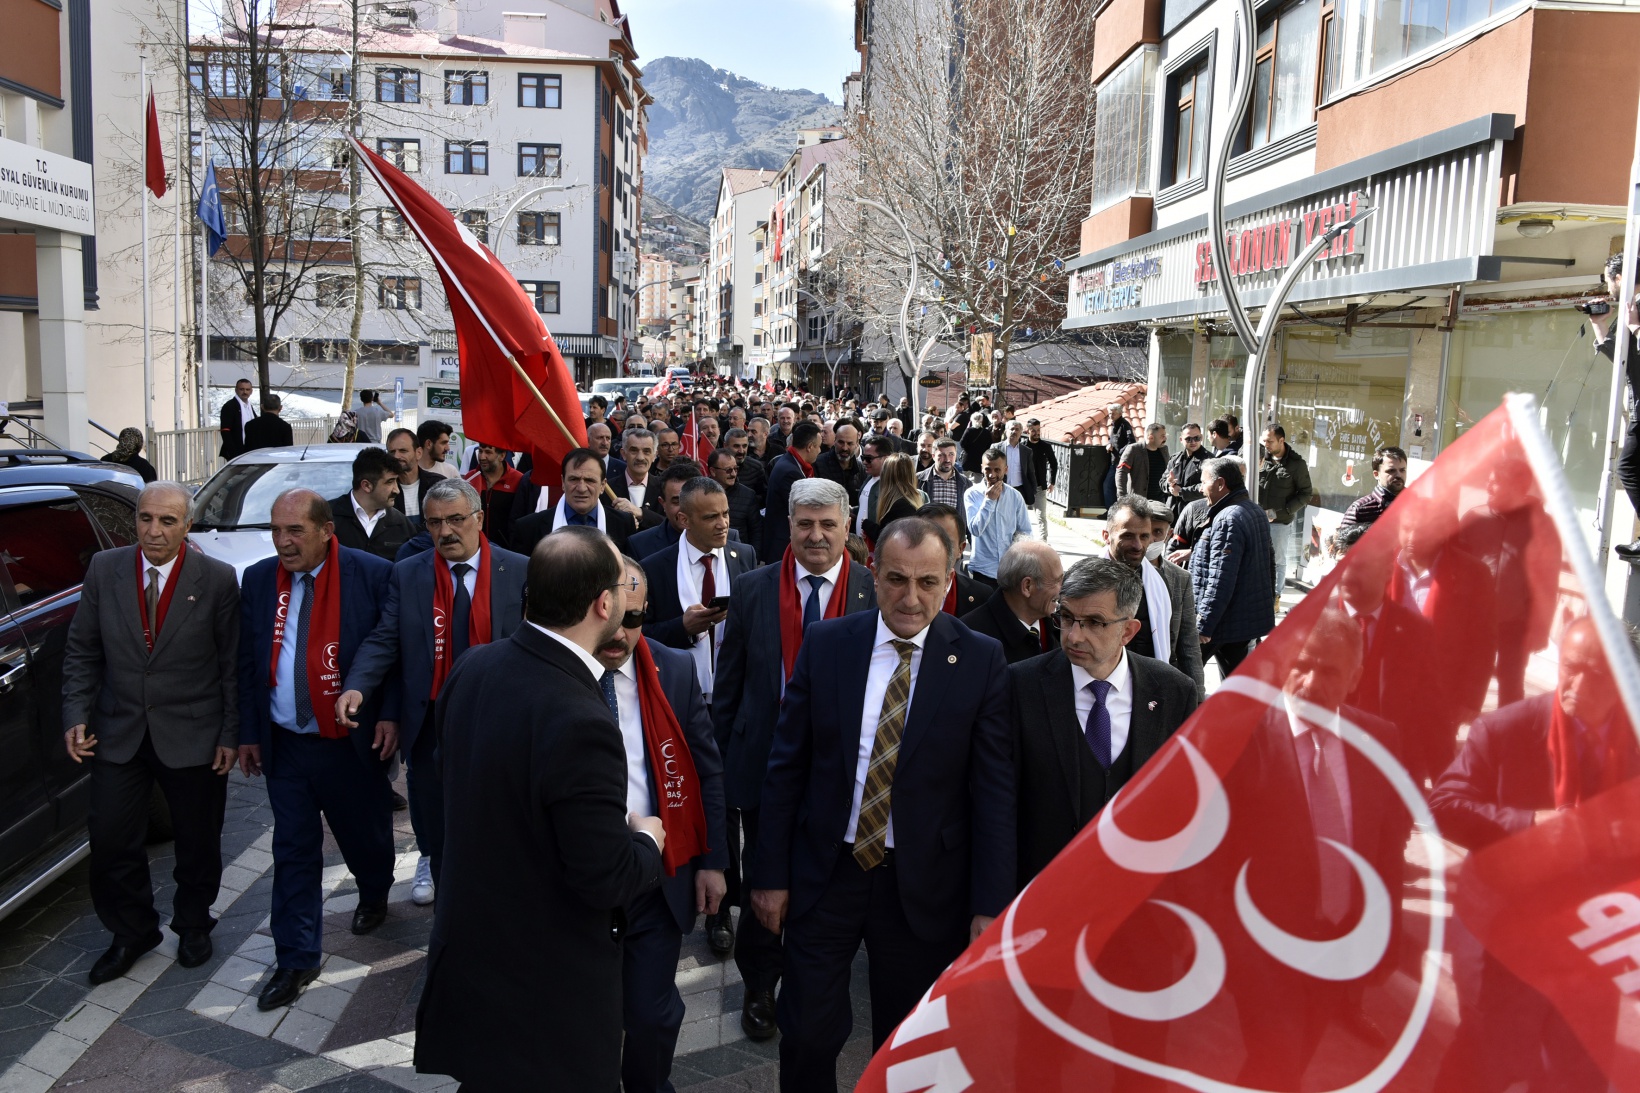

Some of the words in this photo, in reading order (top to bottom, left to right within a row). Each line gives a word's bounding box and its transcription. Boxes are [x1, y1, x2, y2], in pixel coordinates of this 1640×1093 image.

[22, 172, 59, 194] GÜVENLİK
[60, 183, 89, 202] KURUMU
[40, 195, 47, 212] İL
[48, 199, 89, 222] MÜDÜRLÜĞÜ
[1114, 256, 1159, 283] Electrolux
[667, 791, 681, 799] BAŞ
